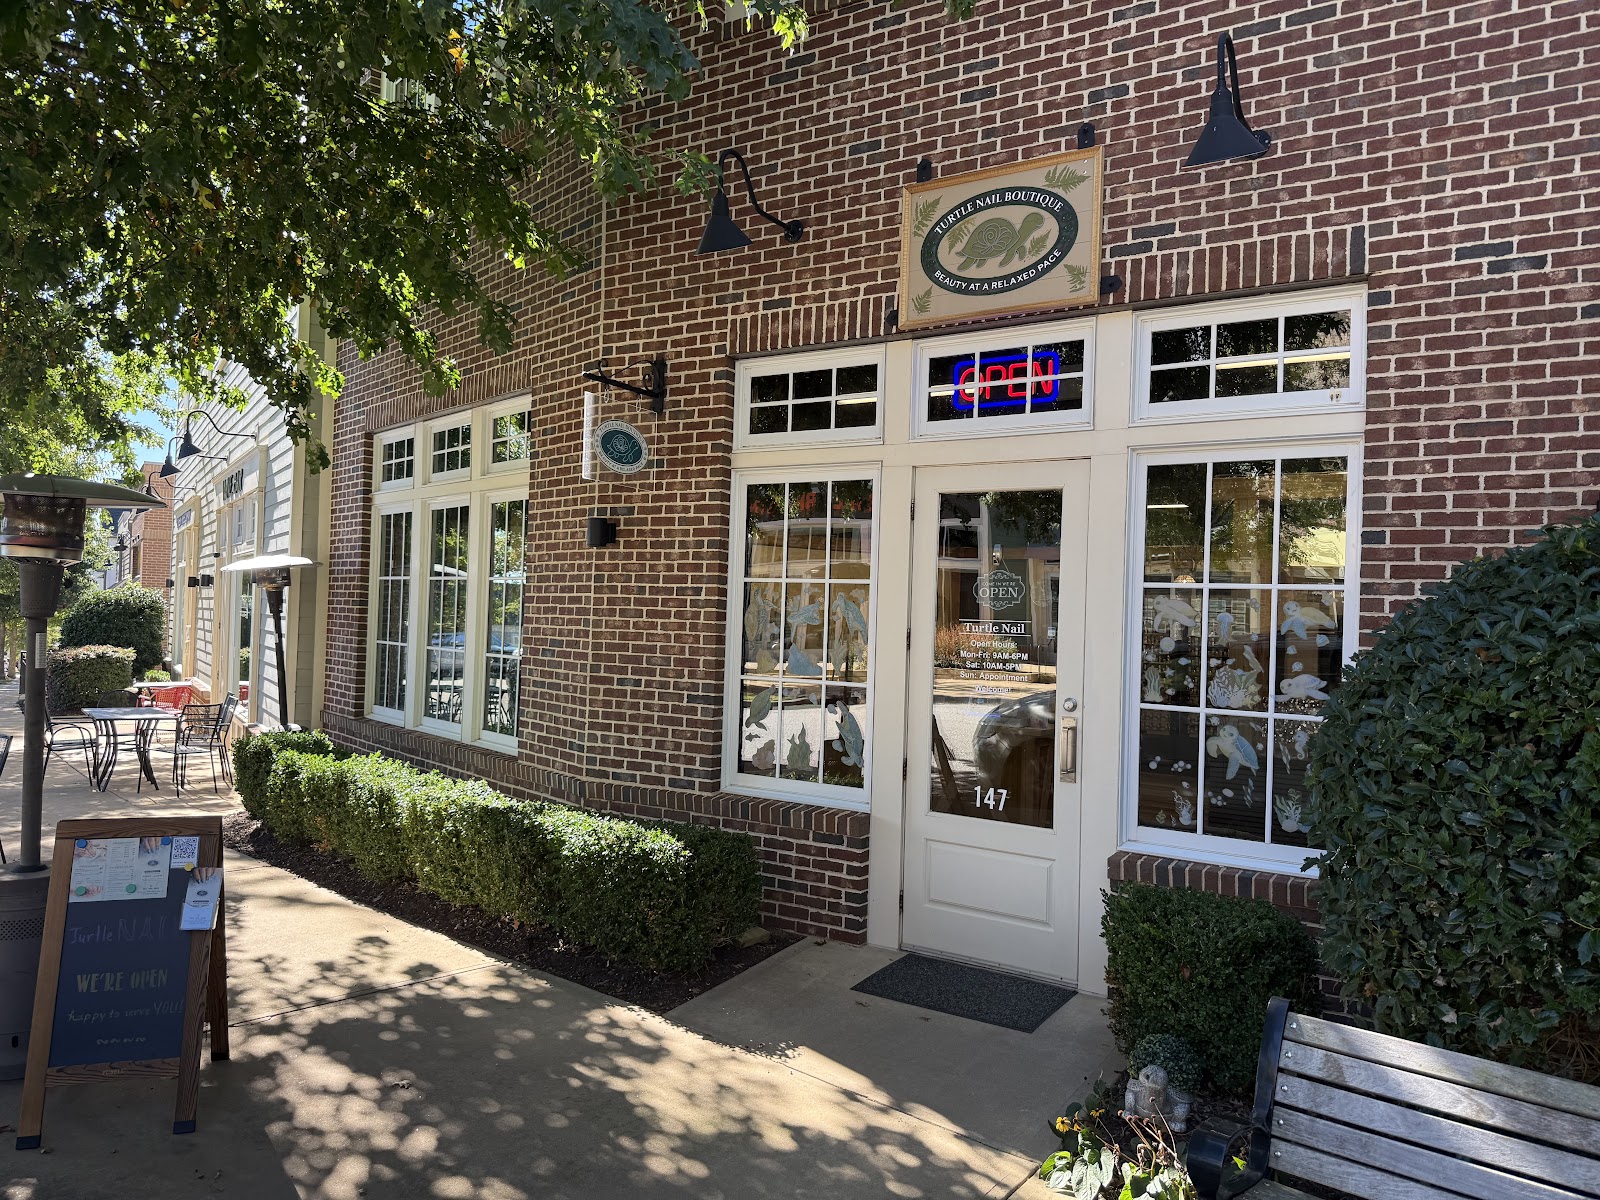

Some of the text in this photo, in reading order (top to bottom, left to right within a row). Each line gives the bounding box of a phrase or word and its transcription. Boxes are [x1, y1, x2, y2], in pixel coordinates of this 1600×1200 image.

[934, 190, 1065, 235] TURTLE NAIL BOUTIQUE
[934, 248, 1062, 291] BEAUTY AT A RELAXED PACE
[959, 359, 1054, 402] OPEN
[979, 587, 1019, 598] OPEN
[964, 622, 1025, 634] Turtle Nail
[970, 640, 1017, 650] Open Hours:
[960, 650, 1028, 661] Mon-Fri: 9AM-6PM
[965, 660, 1022, 671] Sat: 10AM-5PM
[960, 671, 1028, 682] Sun: Appointment
[974, 785, 1008, 811] 147
[76, 969, 169, 993] WE'RE OPEN
[67, 1009, 106, 1024] happy
[109, 1009, 120, 1019] to
